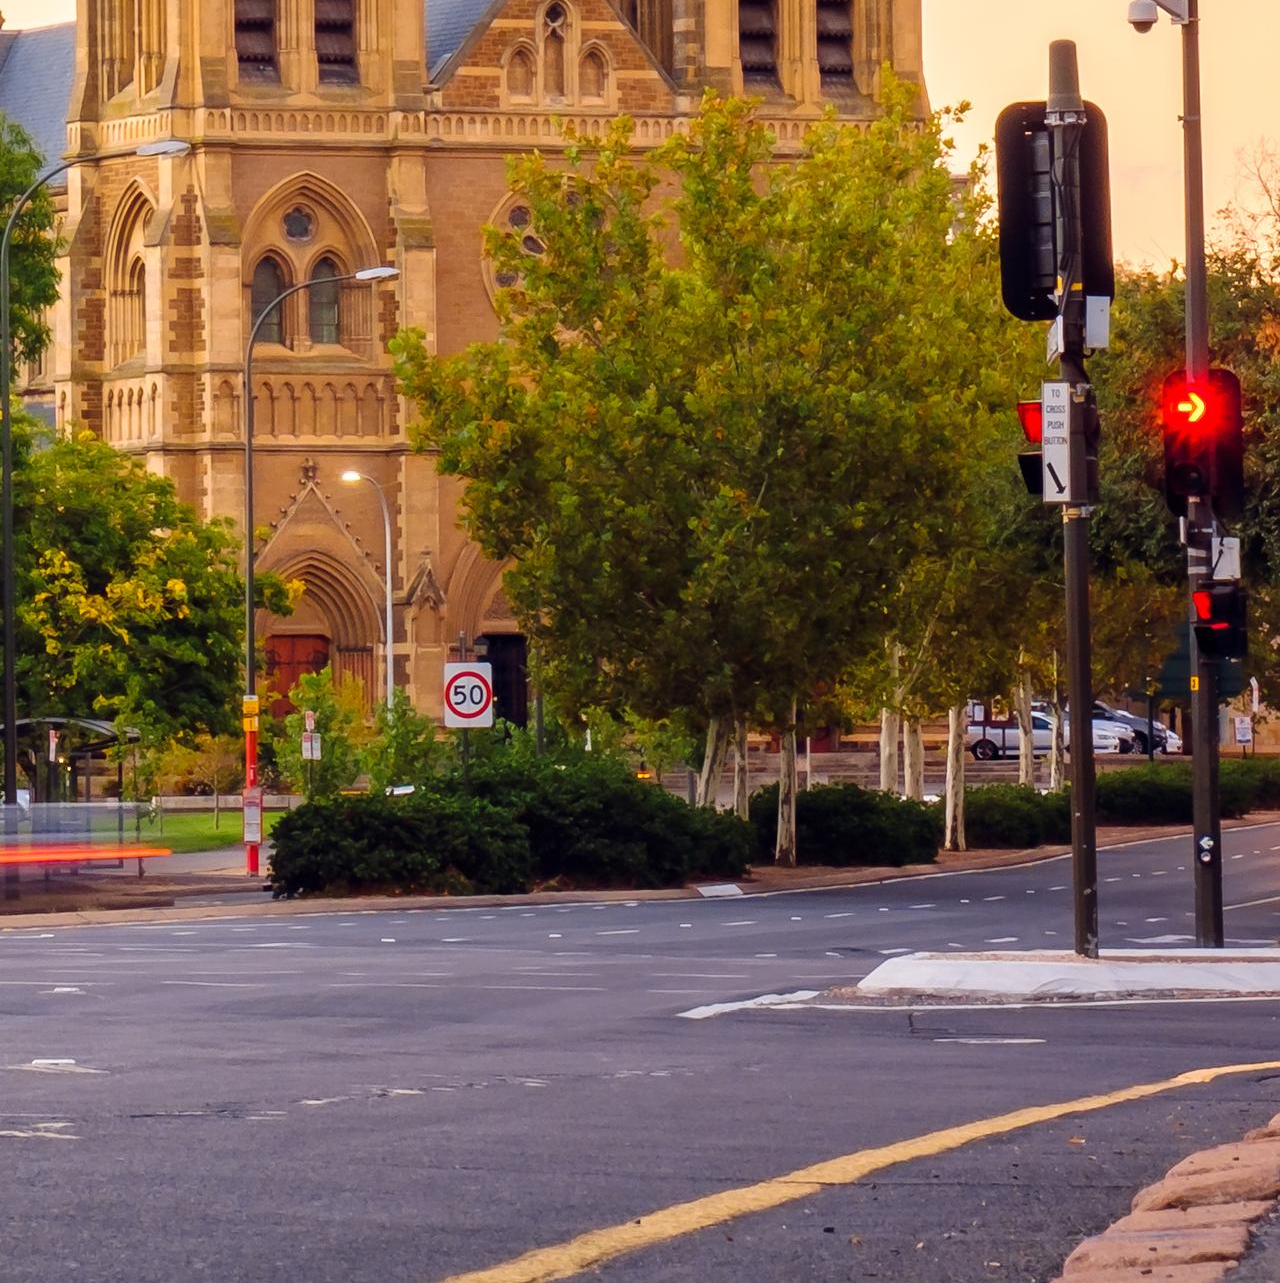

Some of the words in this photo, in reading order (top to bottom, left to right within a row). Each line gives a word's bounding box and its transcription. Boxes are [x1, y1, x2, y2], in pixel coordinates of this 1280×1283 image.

[1051, 389, 1060, 398] TO
[1046, 405, 1066, 414] CROSS
[1048, 421, 1064, 429] PUSH
[1044, 437, 1068, 446] BUTTON
[454, 685, 483, 705] 50
